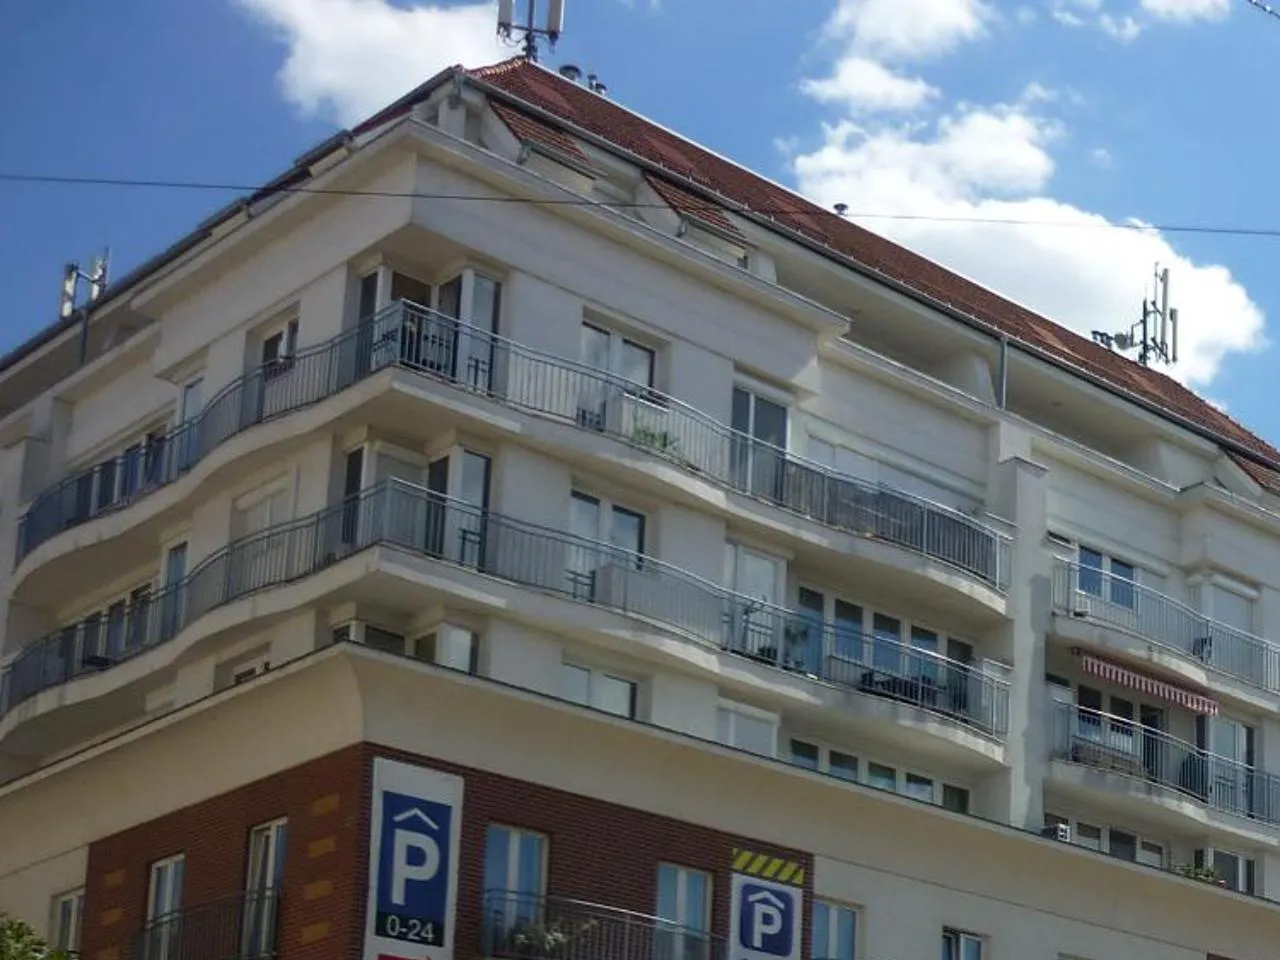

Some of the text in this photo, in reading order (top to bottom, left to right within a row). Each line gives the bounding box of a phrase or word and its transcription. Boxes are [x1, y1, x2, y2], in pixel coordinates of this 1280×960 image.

[391, 828, 440, 906] P
[386, 914, 436, 943] 0-24
[753, 902, 783, 949] P
